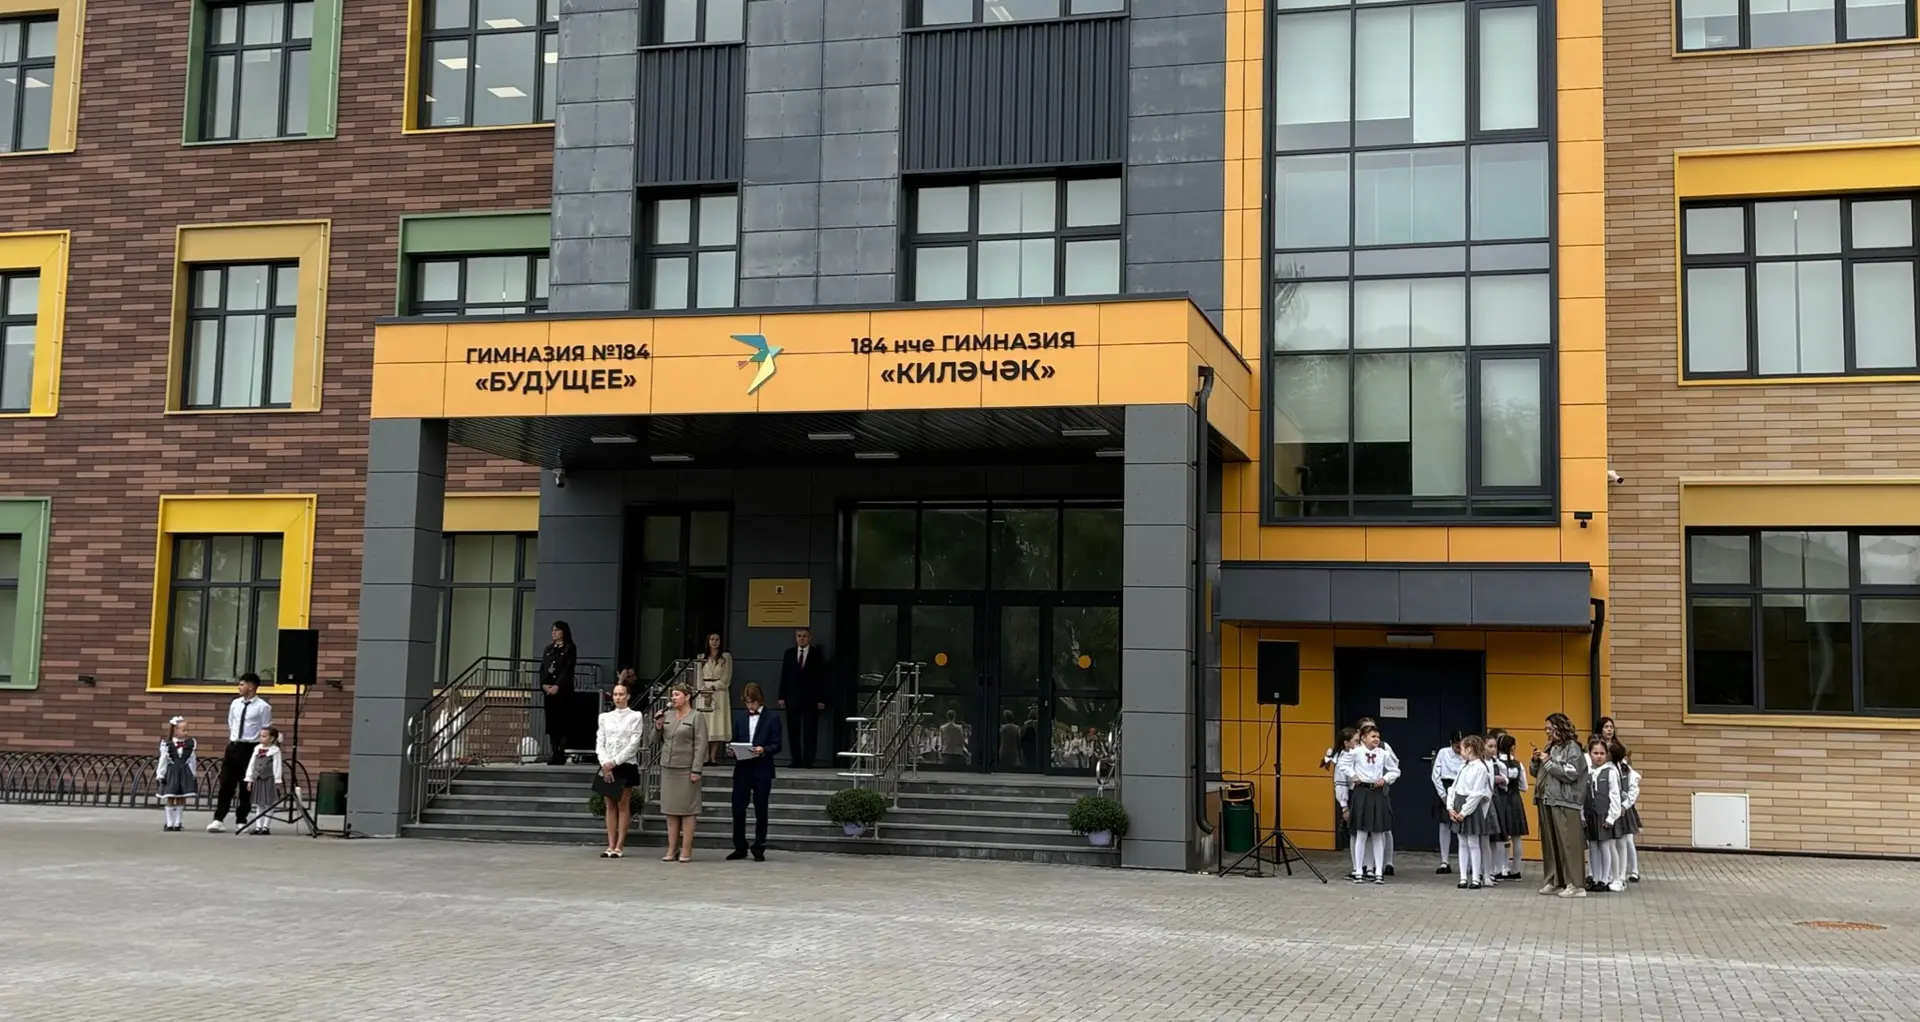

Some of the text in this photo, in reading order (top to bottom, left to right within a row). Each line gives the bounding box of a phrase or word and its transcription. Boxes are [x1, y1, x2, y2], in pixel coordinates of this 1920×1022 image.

[466, 343, 650, 363] ГИМНАЗИЯ №184
[851, 331, 1075, 355] 184 нче ГИМНАЗИЯ
[475, 369, 637, 394] «БУДУЩЕЕ»
[881, 359, 1056, 384] «КИЛӘЧӘК»
